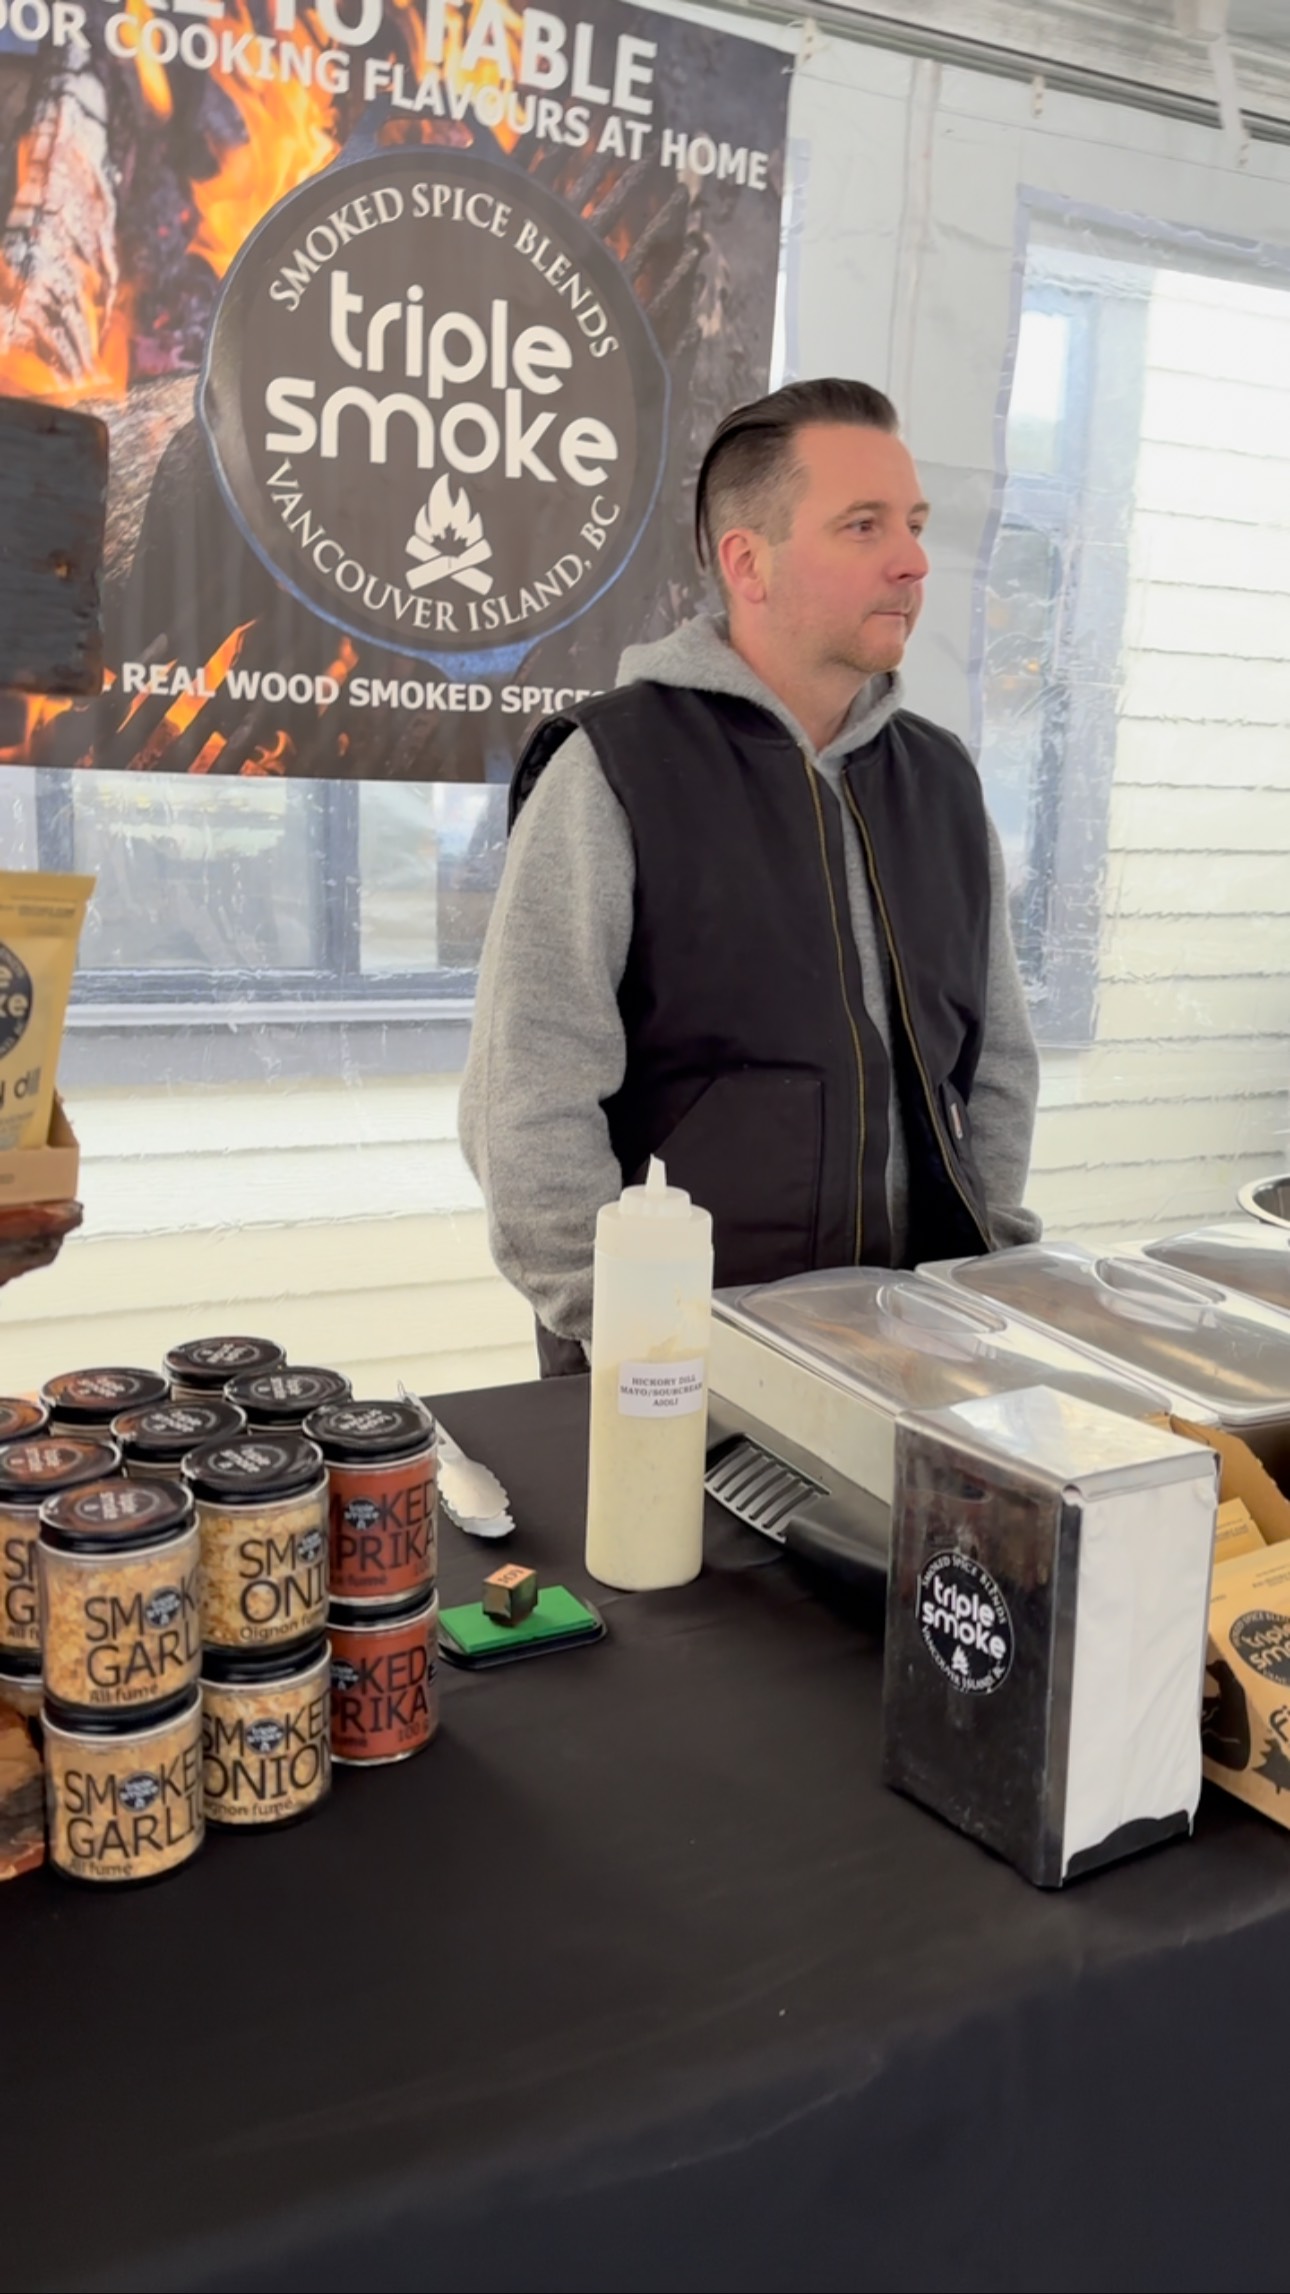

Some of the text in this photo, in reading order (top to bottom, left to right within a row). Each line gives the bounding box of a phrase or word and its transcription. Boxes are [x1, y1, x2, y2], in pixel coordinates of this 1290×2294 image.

[0, 0, 769, 190] OR COOKING FLAVOURS AT HOME
[426, 0, 657, 116] TABLE
[269, 183, 620, 358] SMOKED SPICE BLENDS
[330, 270, 573, 399] triple
[264, 376, 619, 487] smoke
[266, 457, 621, 633] VANCOUVER ISLAND, BC
[122, 662, 606, 714] REAL WOOD SMOKED SPIC
[631, 1376, 676, 1387] HICKORY
[922, 1601, 1006, 1660] smoke
[934, 1575, 995, 1628] triple
[86, 1620, 200, 1690] GARL
[66, 1789, 202, 1861] GARLI
